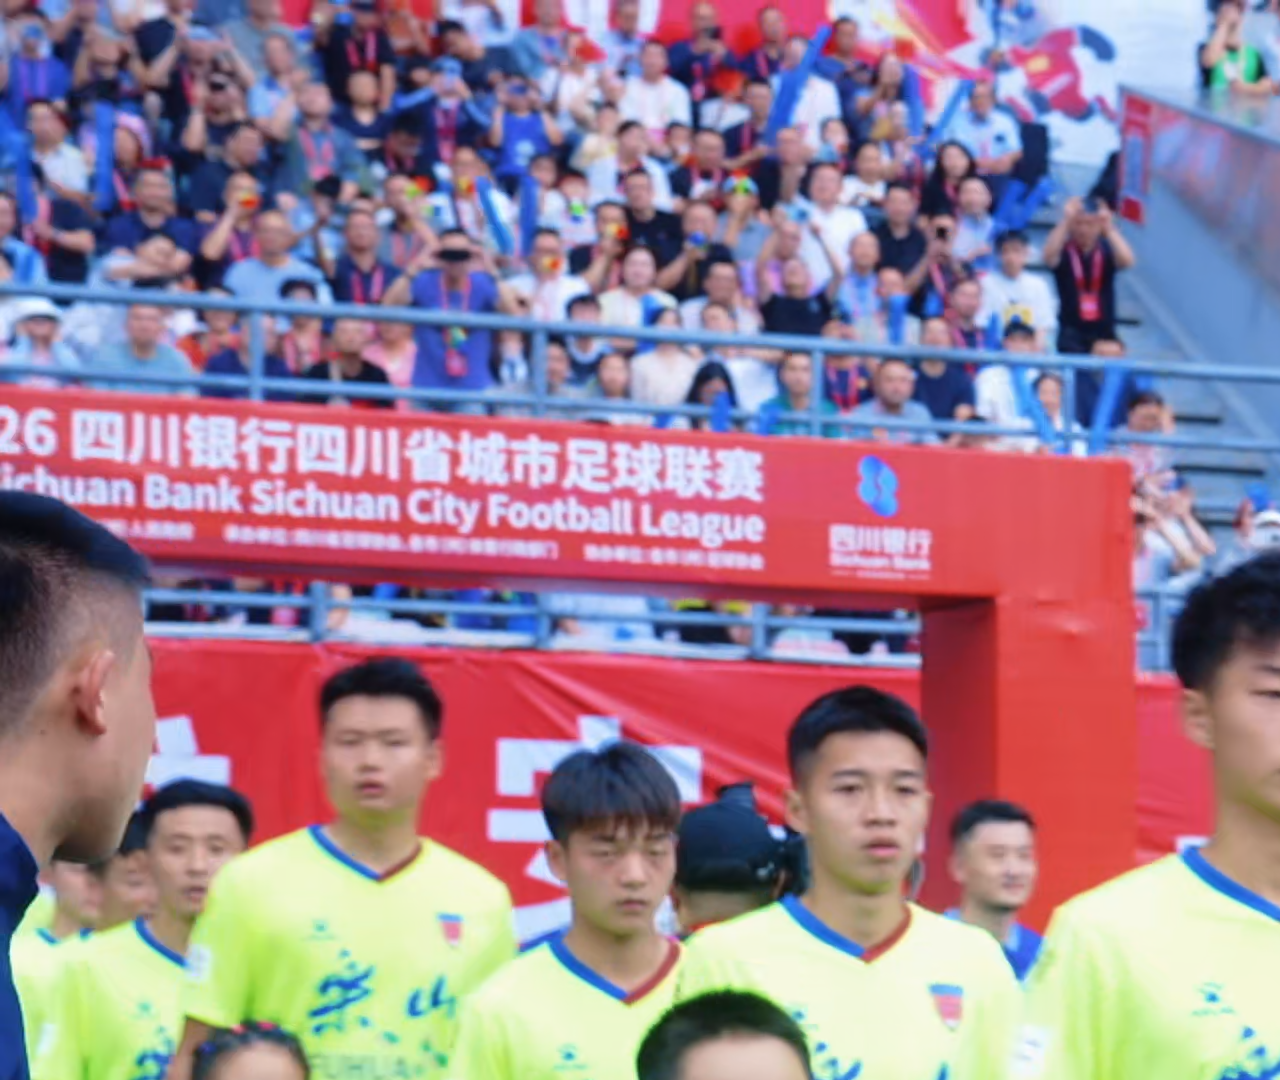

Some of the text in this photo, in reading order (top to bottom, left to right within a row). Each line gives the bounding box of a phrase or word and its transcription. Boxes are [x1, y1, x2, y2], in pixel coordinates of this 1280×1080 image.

[70, 408, 764, 502] 四川银行四川省城市足球联赛
[0, 461, 765, 548] ichuan Bank Sichuan City Football League
